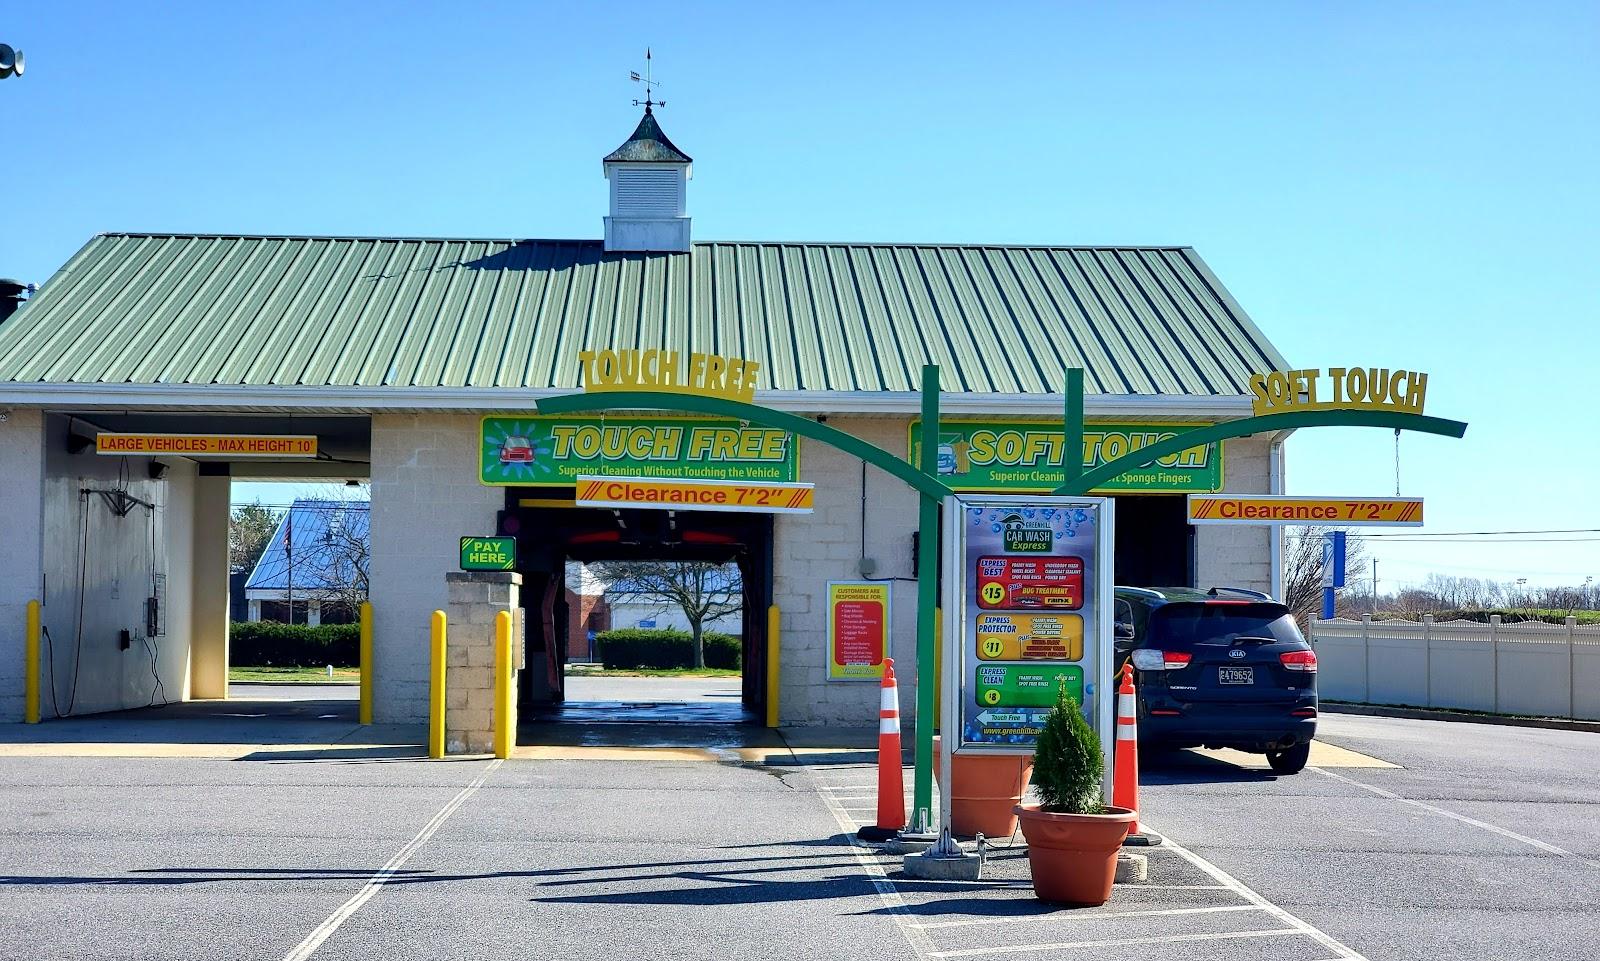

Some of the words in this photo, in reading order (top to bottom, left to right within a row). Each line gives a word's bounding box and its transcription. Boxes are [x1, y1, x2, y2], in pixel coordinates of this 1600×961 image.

[580, 349, 678, 388] TOUCH
[688, 352, 760, 395] FREE
[1250, 369, 1320, 407] SOFT
[1329, 367, 1428, 408] TOUCH
[101, 438, 143, 450] LARGE
[147, 439, 207, 451] VEHICLES
[218, 439, 245, 451] MAX
[249, 440, 294, 452] HEIGHT
[297, 440, 313, 452] 10'
[552, 424, 683, 461] TOUCH
[687, 427, 789, 463] FREE
[967, 430, 1066, 466] SOFT
[559, 465, 599, 477] Superior
[601, 466, 642, 478] Cleaning
[643, 466, 683, 477] Without
[684, 467, 726, 479] Touching
[728, 467, 744, 477] the
[746, 468, 780, 478] Vehicle
[990, 470, 1030, 483] Superior
[1031, 470, 1065, 482] Cleanin
[1122, 472, 1157, 484] Sponge
[1158, 472, 1192, 484] Fingers
[606, 484, 727, 504] Clearance
[734, 488, 784, 505] 7'2"
[1219, 501, 1338, 519] Clearance
[1346, 503, 1393, 519] 7'2"
[1006, 531, 1023, 541] CAR
[1025, 531, 1050, 542] WASH
[474, 542, 501, 552] PAY
[1012, 541, 1046, 551] Express
[469, 553, 506, 563] HERE
[980, 559, 1007, 567] EXPRESS
[983, 568, 1004, 576] BEST
[985, 588, 1001, 599] $15
[985, 616, 1010, 624] EXPRESS
[978, 625, 1017, 633] PROTECTOR
[986, 643, 999, 652] $11
[983, 676, 1003, 684] CLEAN
